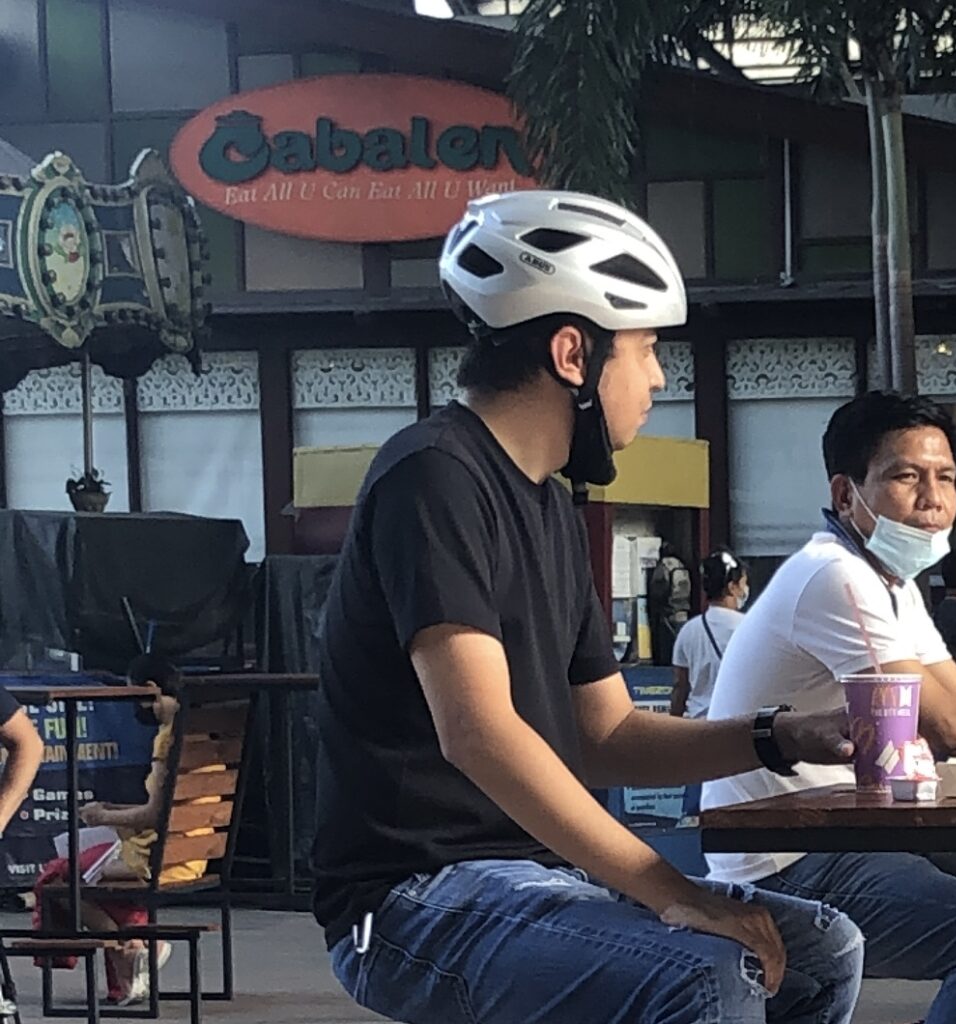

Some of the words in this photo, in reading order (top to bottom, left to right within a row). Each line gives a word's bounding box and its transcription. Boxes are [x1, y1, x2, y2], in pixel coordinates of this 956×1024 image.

[199, 110, 533, 184] Cabalen
[225, 187, 257, 205] Eat
[263, 183, 293, 202] All
[300, 183, 317, 201] U
[322, 183, 361, 200] Can
[367, 182, 401, 200] Eat
[408, 181, 438, 200] All
[444, 181, 461, 199] U
[523, 254, 551, 272] ABUS
